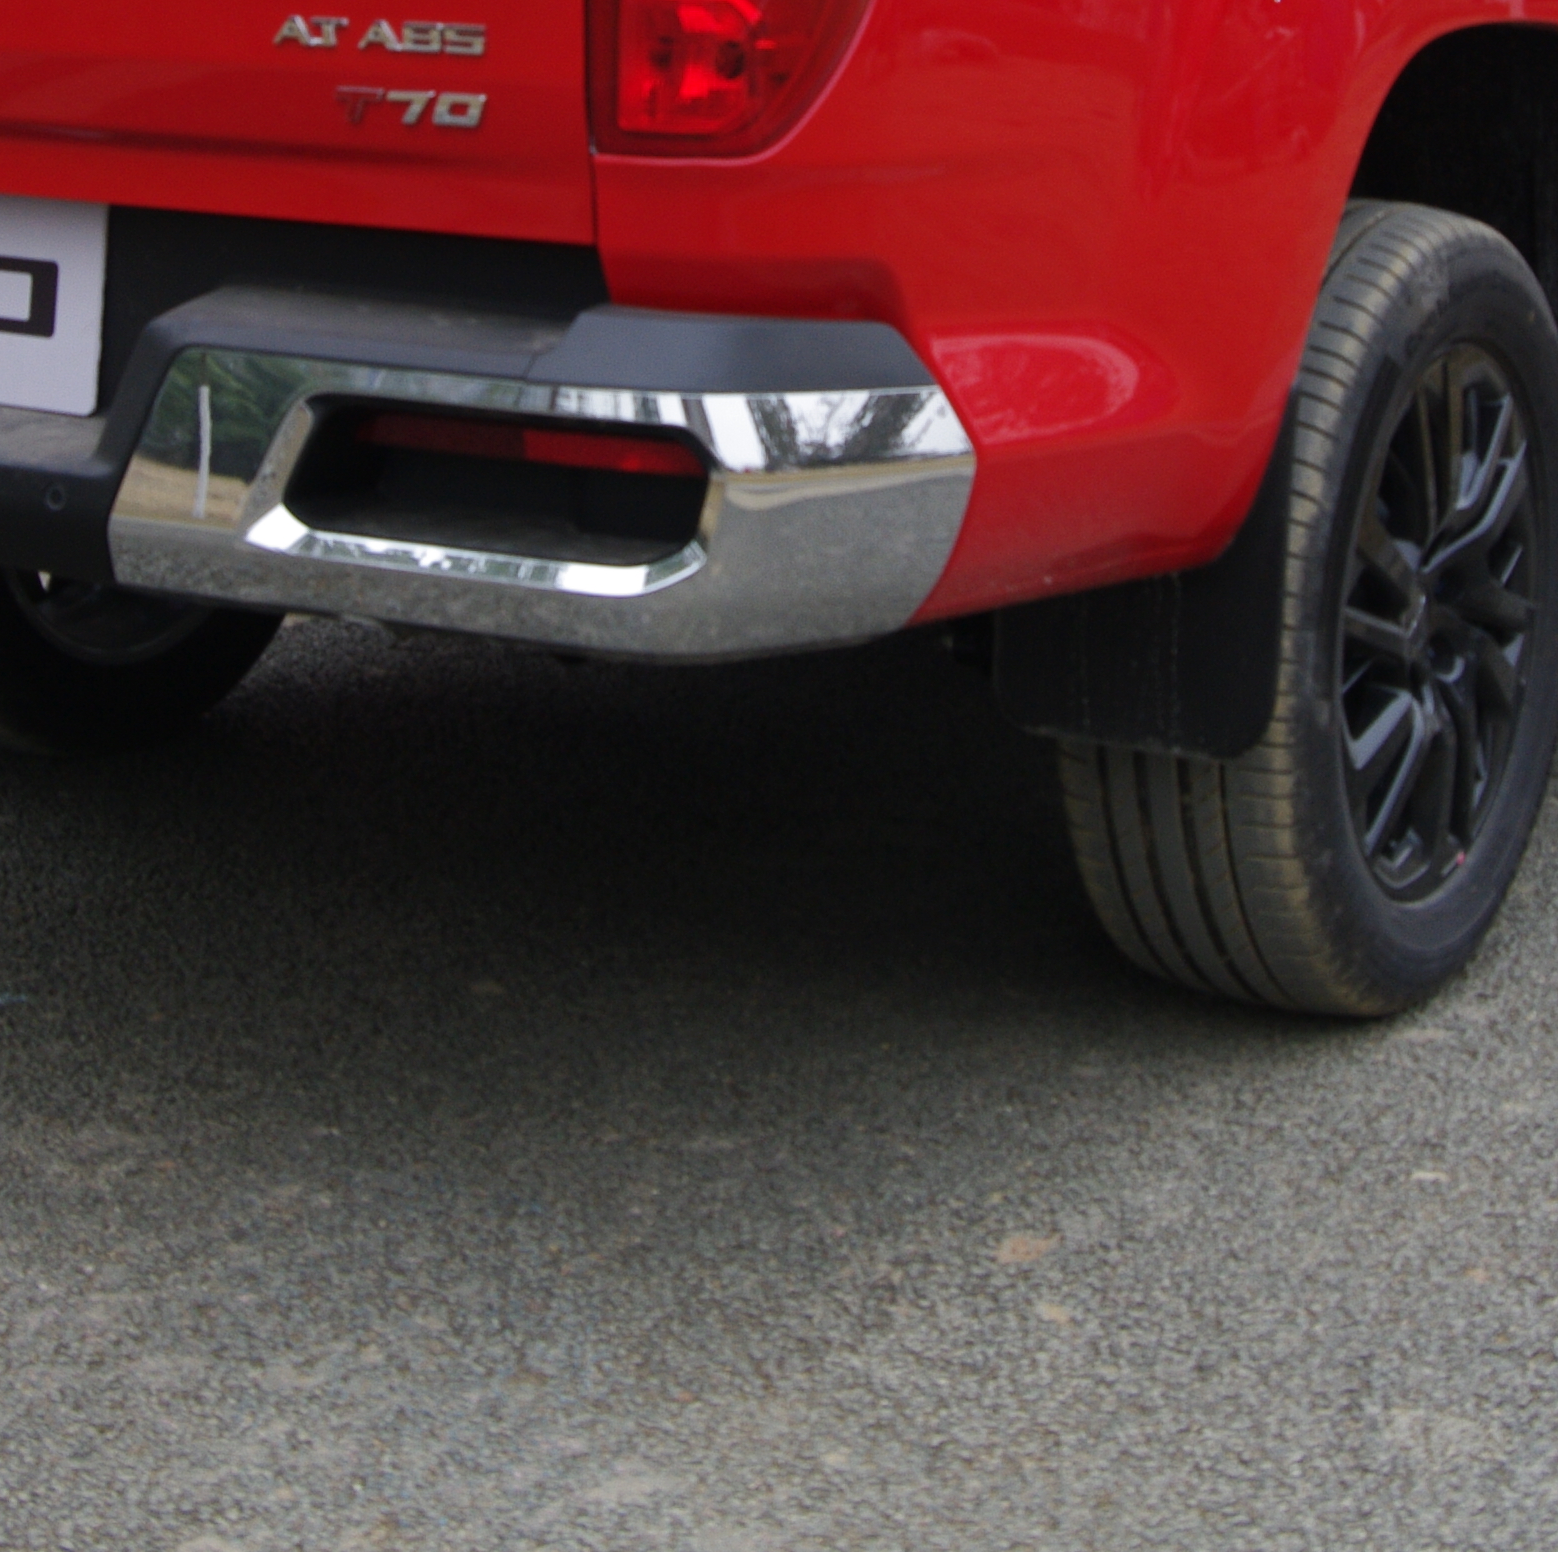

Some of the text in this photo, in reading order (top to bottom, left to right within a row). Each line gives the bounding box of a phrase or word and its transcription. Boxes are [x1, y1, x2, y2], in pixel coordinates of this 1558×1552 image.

[273, 13, 487, 56] AT ABS
[335, 84, 488, 129] T70
